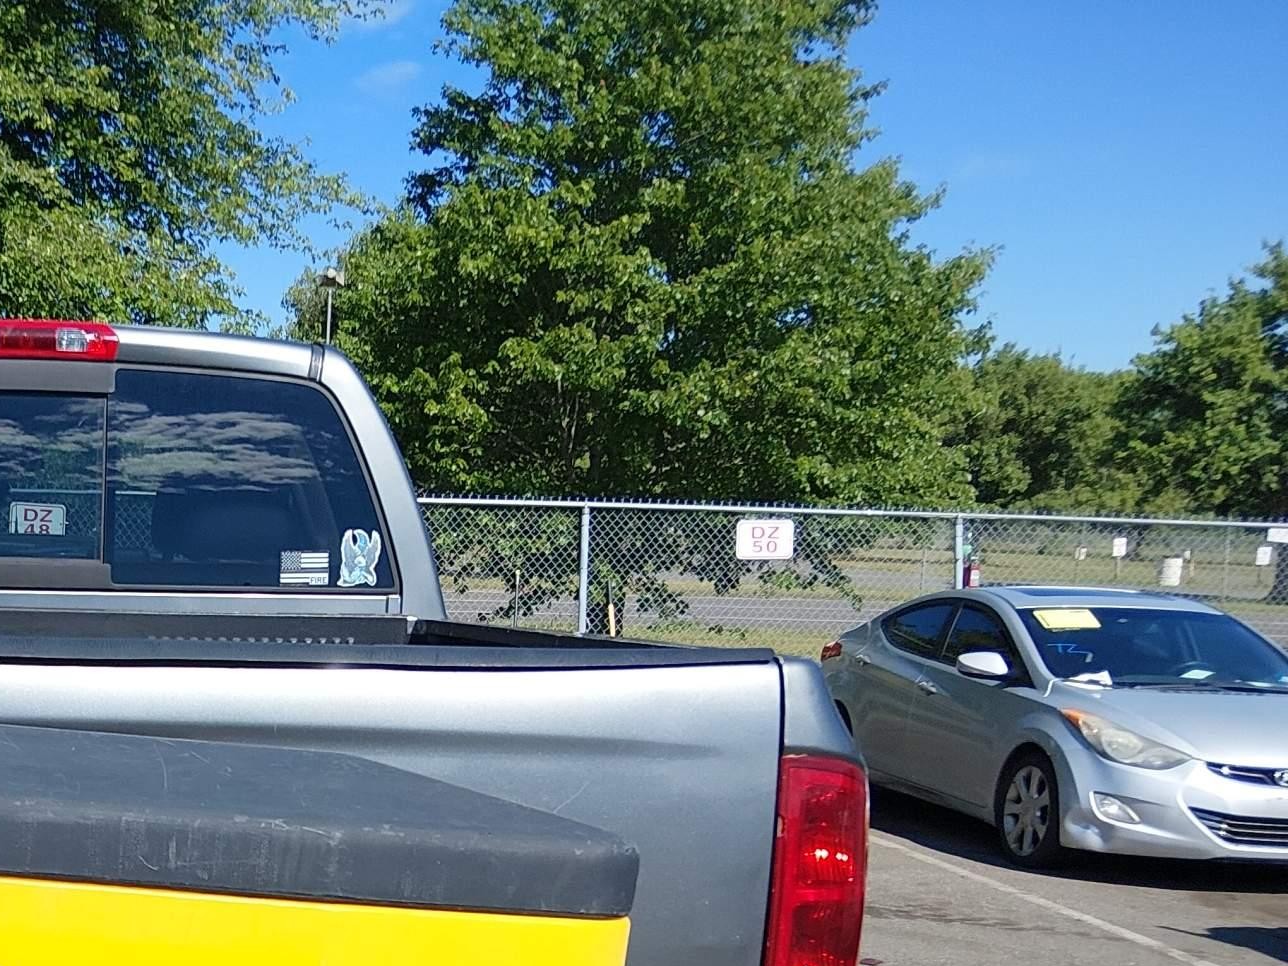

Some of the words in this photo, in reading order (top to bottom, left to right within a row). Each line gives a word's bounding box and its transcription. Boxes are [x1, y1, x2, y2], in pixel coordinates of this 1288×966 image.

[23, 508, 53, 522] DZ
[24, 523, 50, 535] 48
[751, 526, 780, 540] DZ
[752, 540, 777, 553] 50
[310, 576, 327, 584] FIRE
